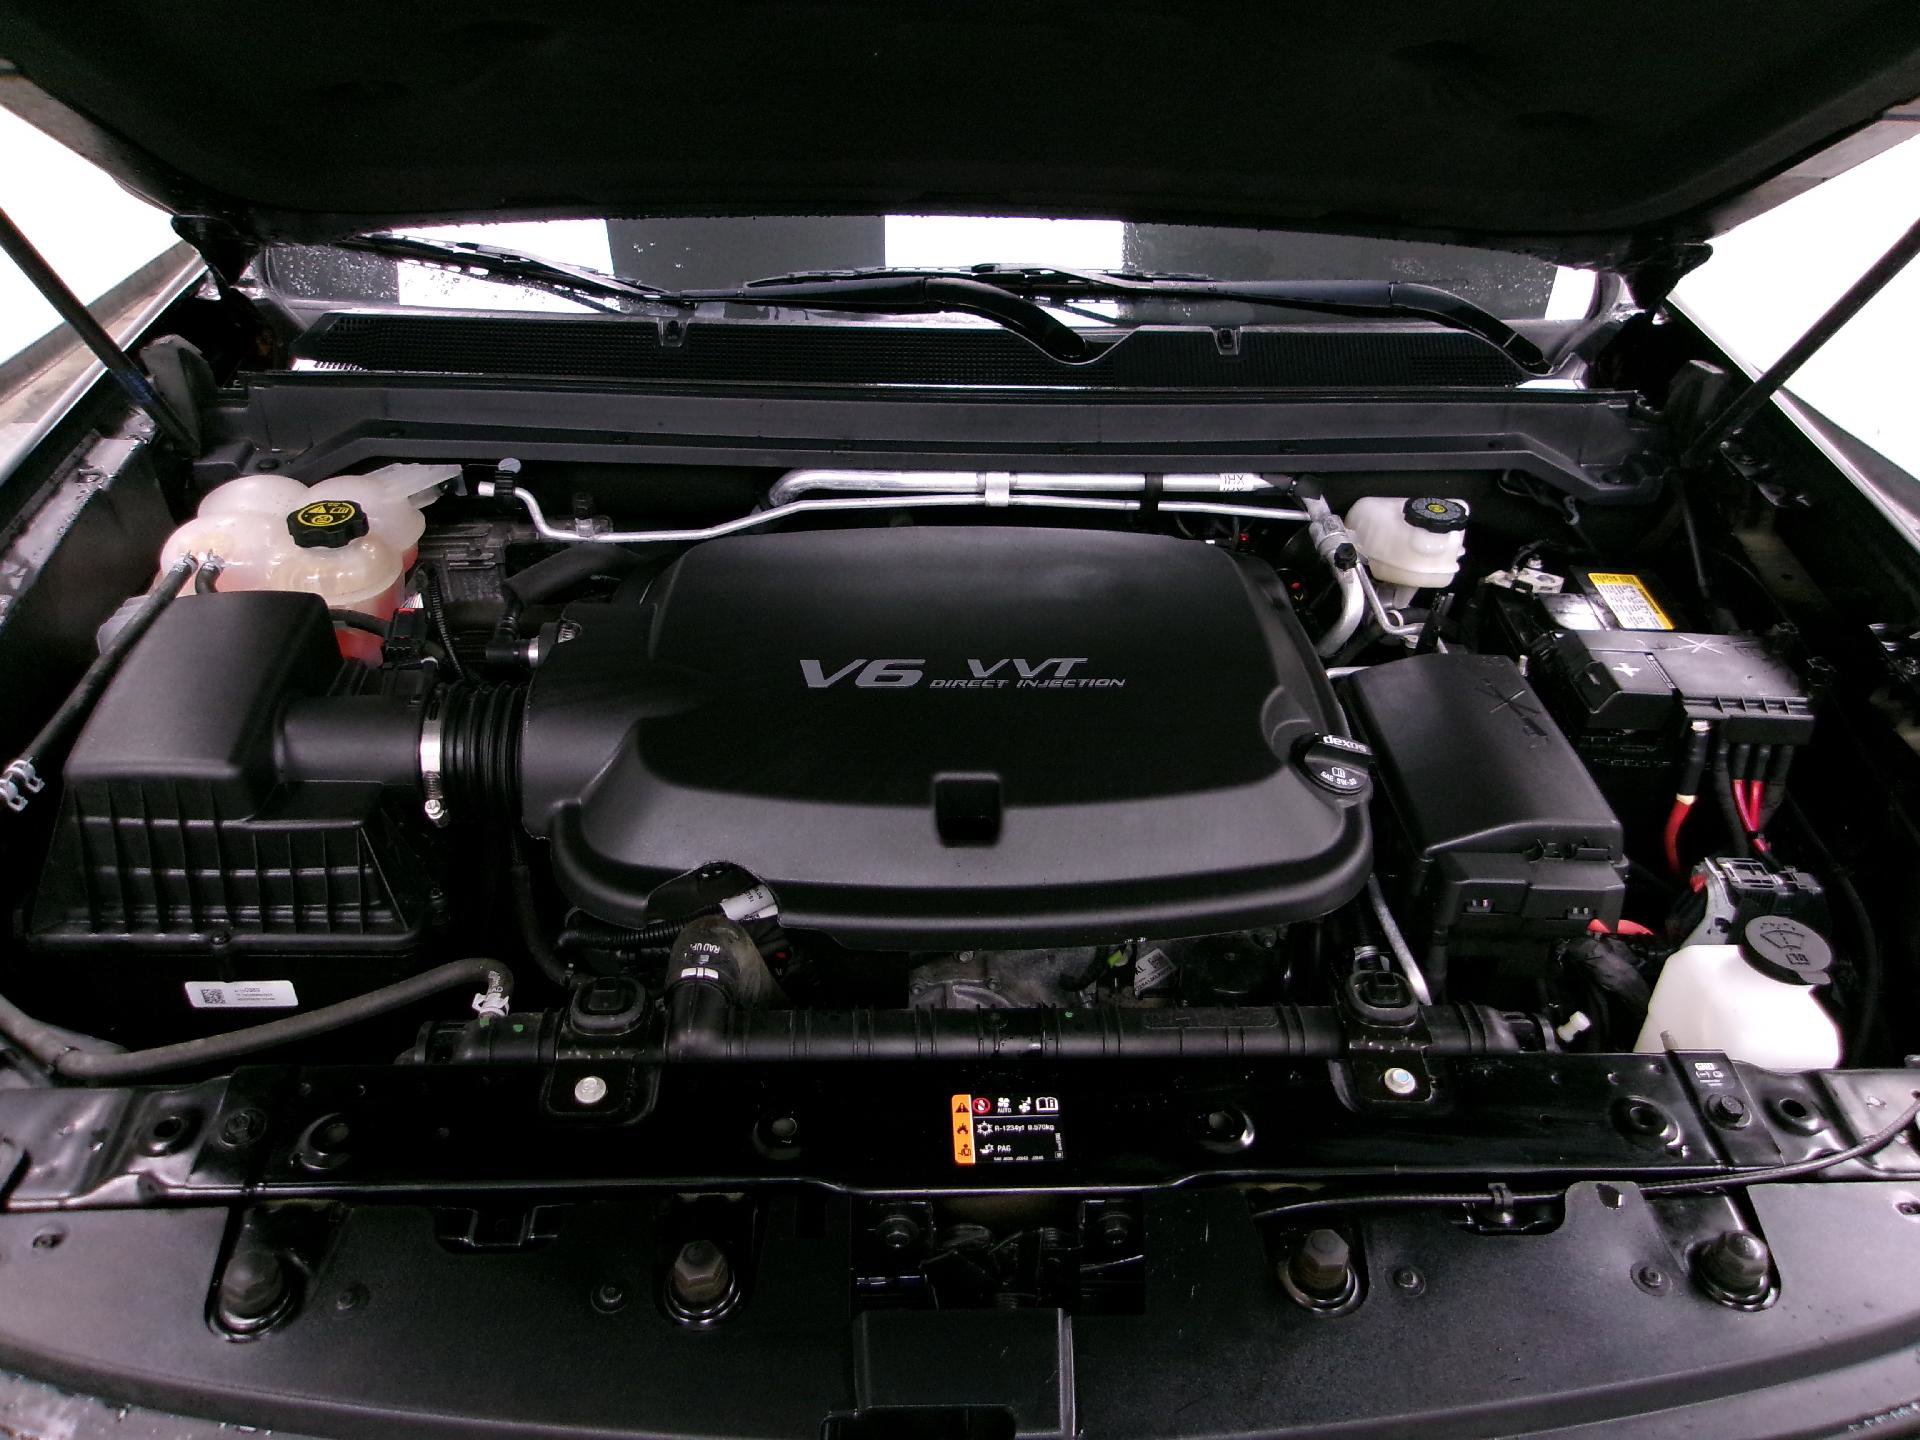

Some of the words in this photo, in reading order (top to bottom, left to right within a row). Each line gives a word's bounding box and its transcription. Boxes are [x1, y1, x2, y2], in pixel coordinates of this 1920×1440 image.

[800, 659, 926, 689] V6
[967, 657, 1088, 679] VVT
[929, 679, 1009, 689] DIRECT
[1016, 678, 1126, 688] INJECTION
[1323, 735, 1367, 752] dexos
[1320, 771, 1334, 782] SAE
[997, 1144, 1012, 1152] PAG
